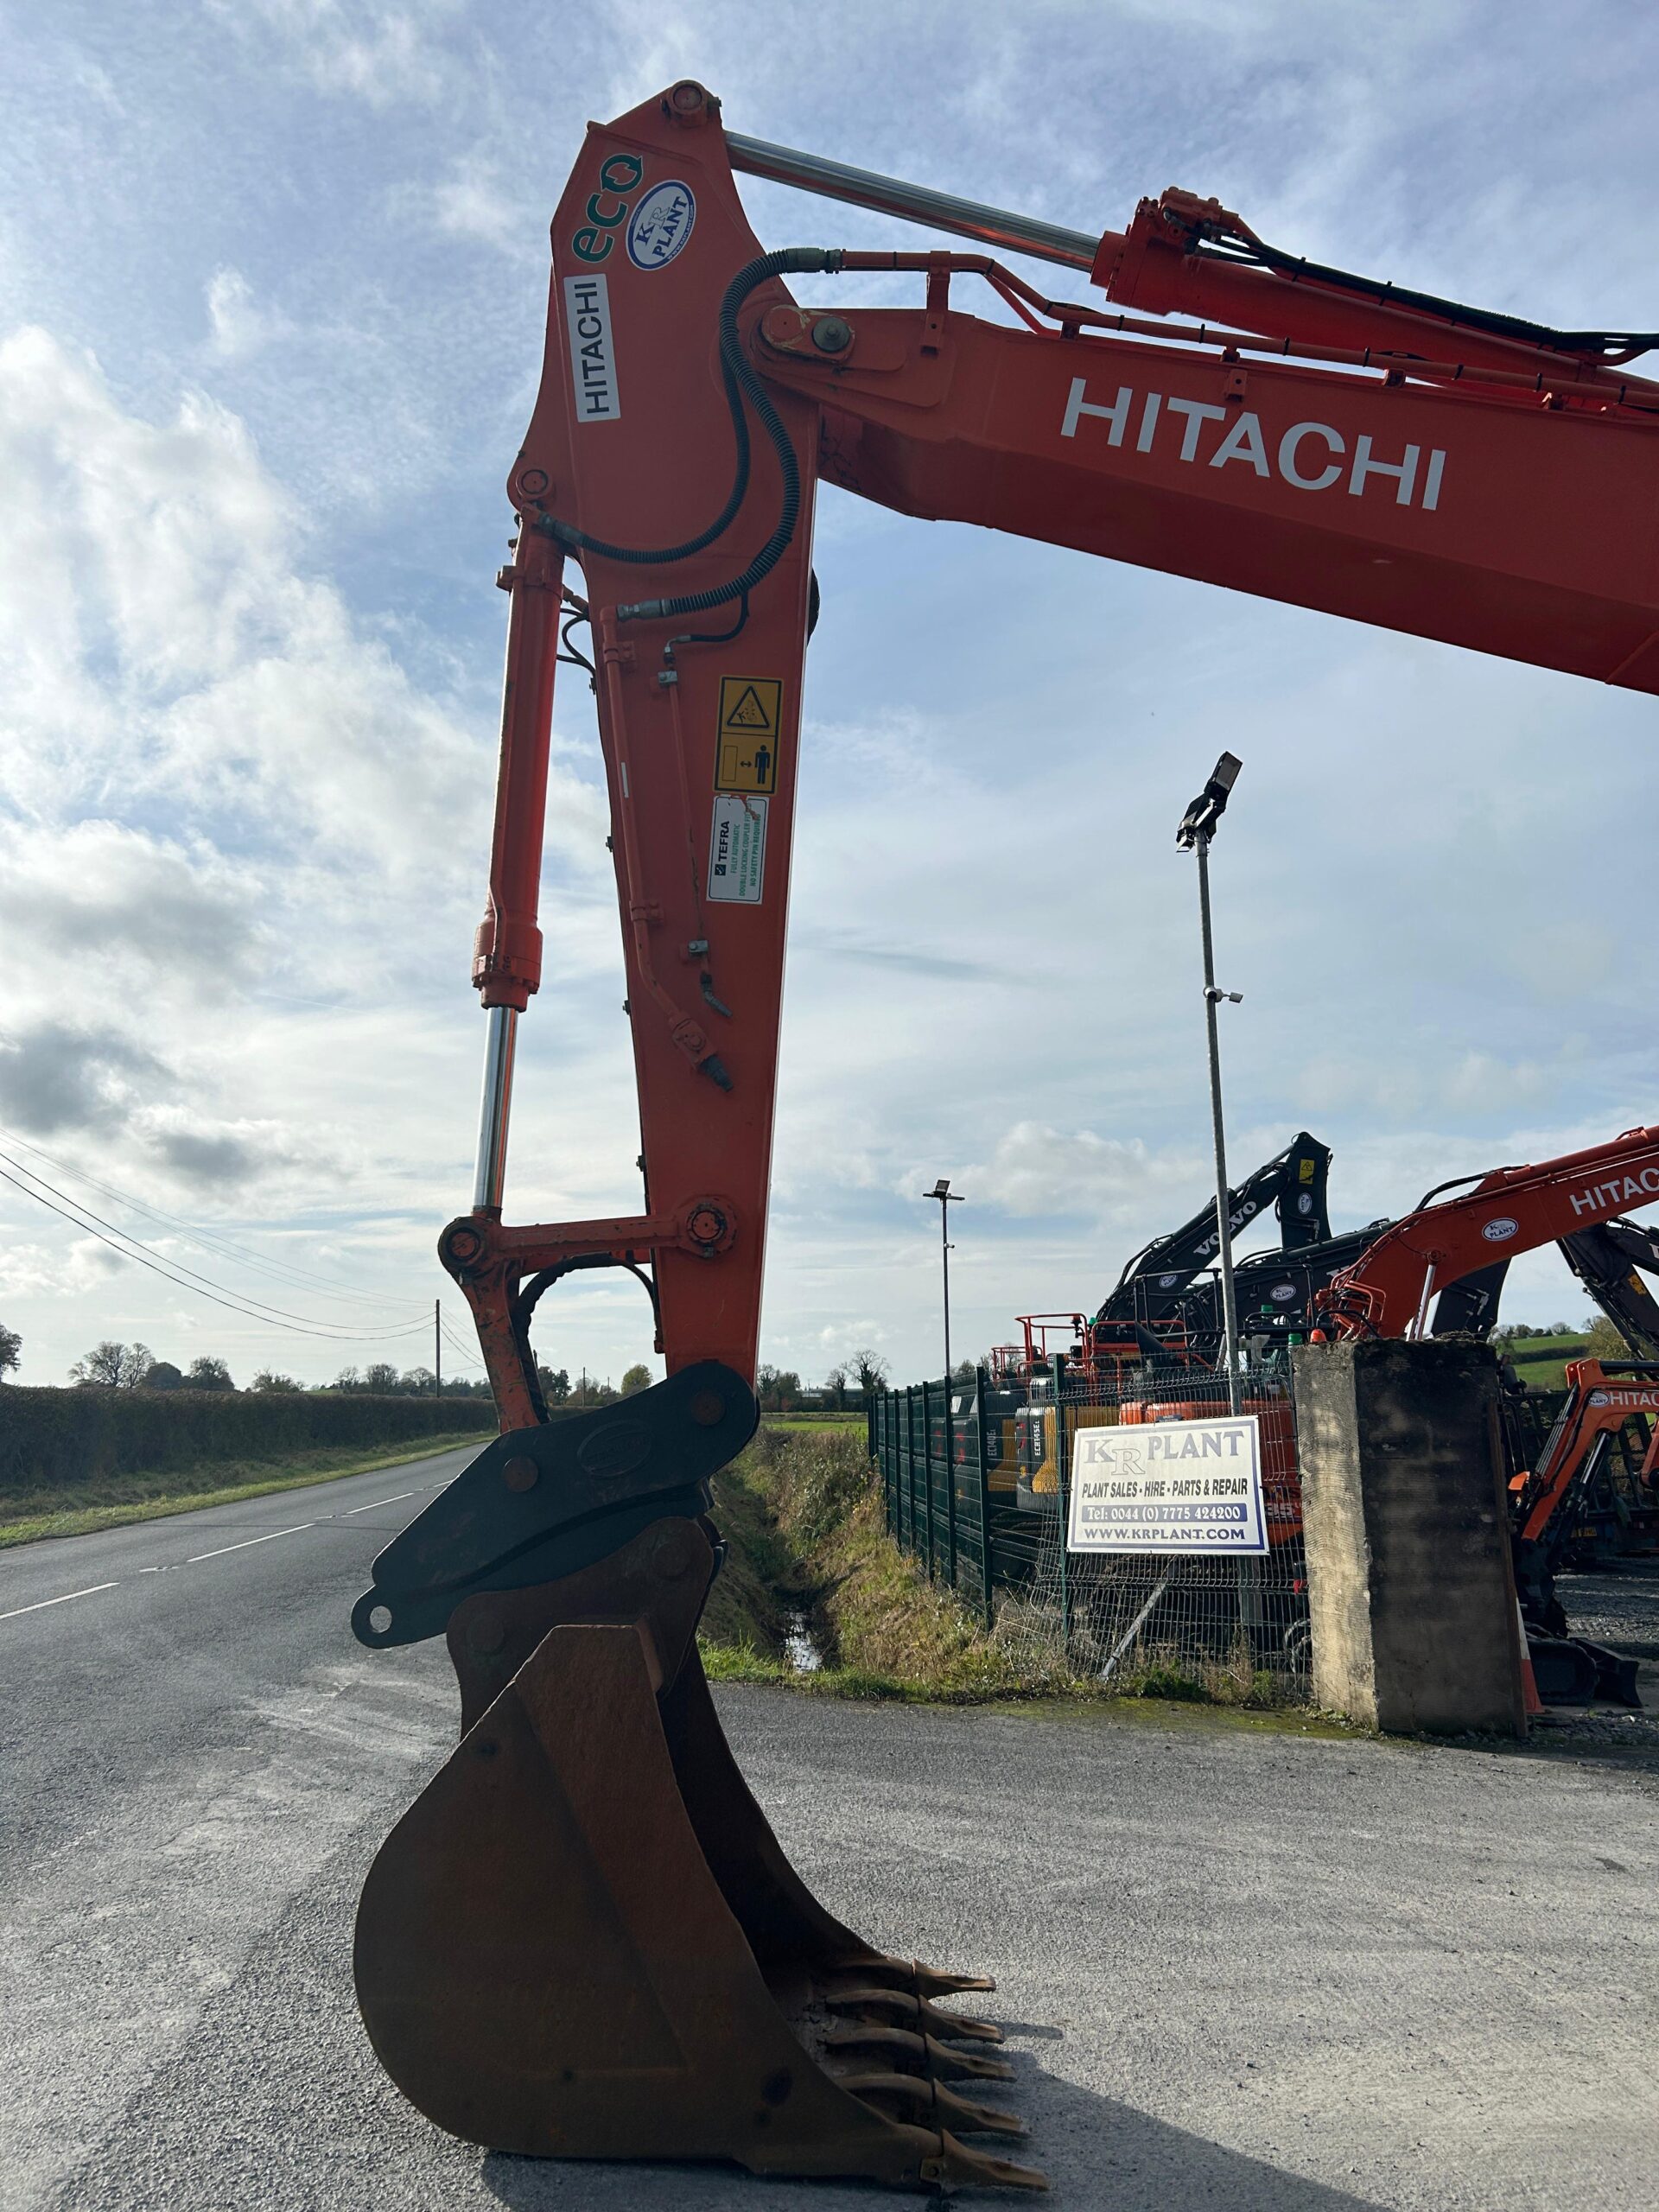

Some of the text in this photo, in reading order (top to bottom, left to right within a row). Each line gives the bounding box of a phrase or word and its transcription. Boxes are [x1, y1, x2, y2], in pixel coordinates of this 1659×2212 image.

[572, 153, 644, 264] eco
[652, 195, 689, 257] PLANT
[575, 281, 609, 414] HITACHI
[1061, 377, 1446, 511] HITACHI
[718, 821, 730, 861] TEFRA
[732, 823, 741, 856] AUTOMATIC
[739, 874, 747, 896] DOUBLE
[749, 877, 756, 887] NO
[1569, 1167, 1659, 1216] HITAC
[1490, 1226, 1514, 1238] PLANT
[1084, 1430, 1244, 1476] KR PLANT
[1082, 1482, 1109, 1498] PLANT
[1109, 1481, 1137, 1497] SALES
[1144, 1480, 1166, 1497] HIRE
[1172, 1479, 1201, 1496] PARTS
[1203, 1480, 1210, 1496] &
[1211, 1478, 1248, 1496] REPAIR
[1087, 1506, 1240, 1522] Tel: 0044 (0) 7775 424200
[1084, 1528, 1245, 1540] WWW.KRPLANT.COM
